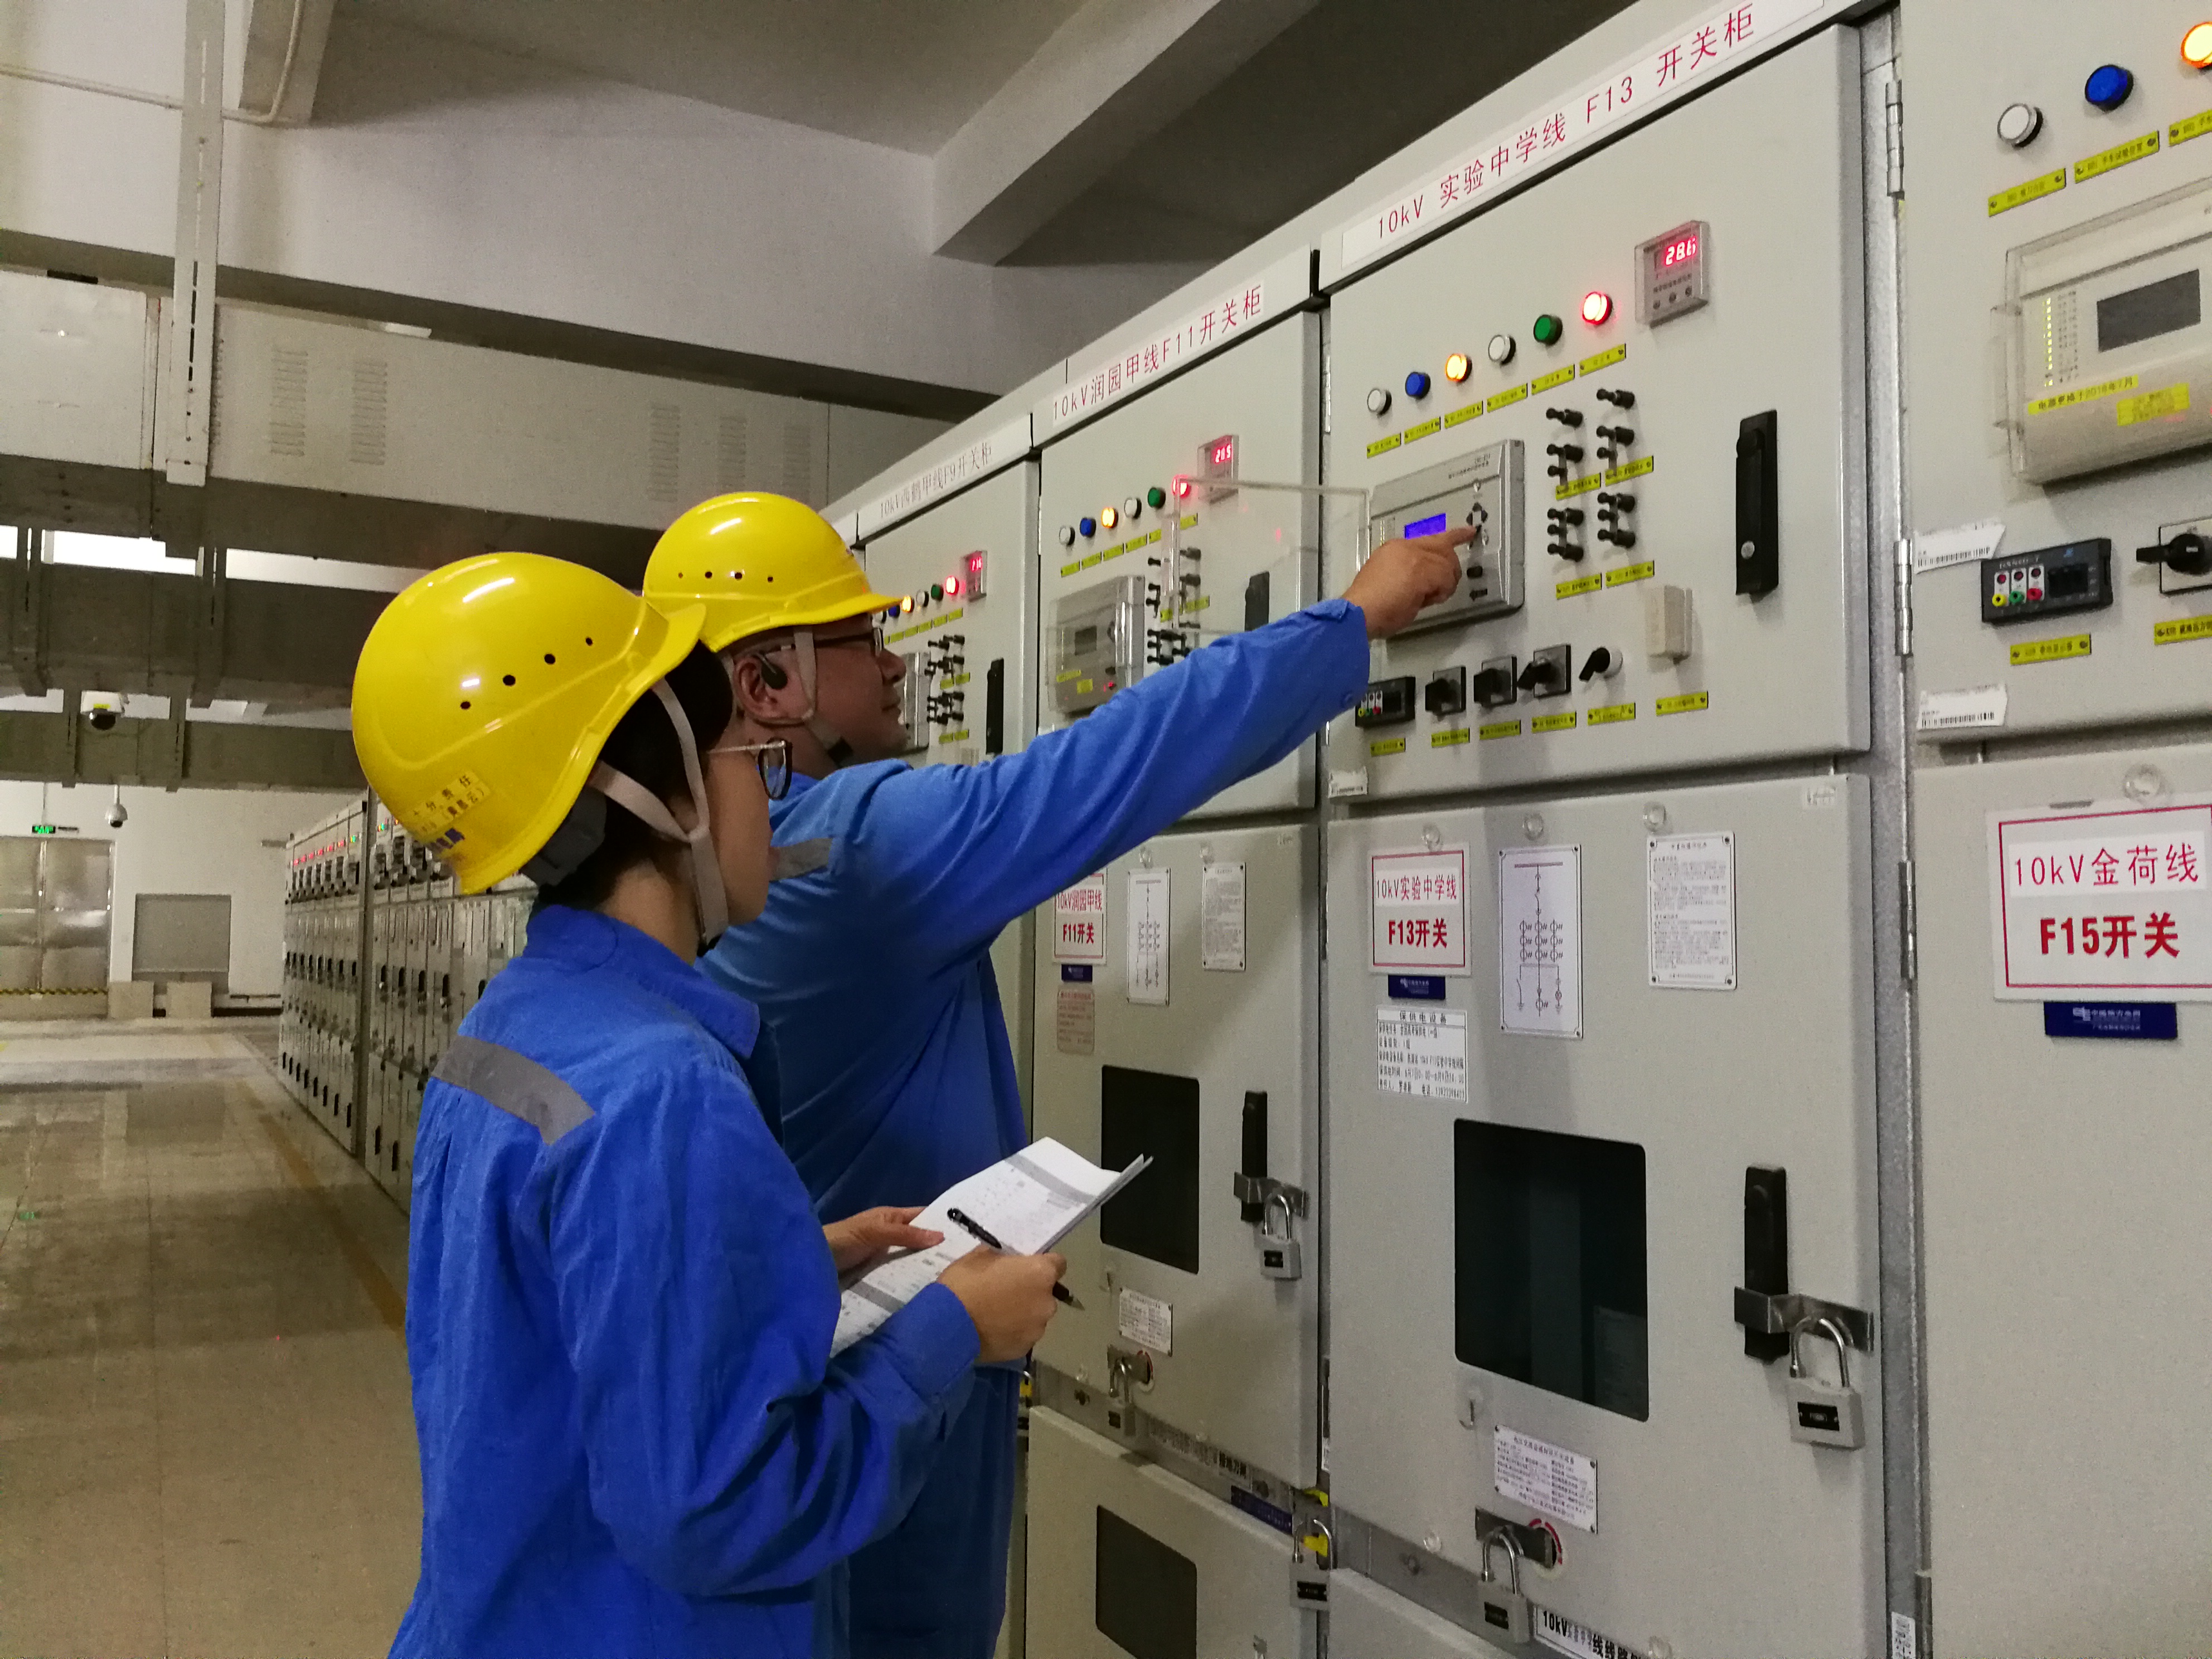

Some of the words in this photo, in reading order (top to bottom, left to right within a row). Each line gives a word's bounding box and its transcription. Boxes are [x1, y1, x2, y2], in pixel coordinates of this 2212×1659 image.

[1379, 196, 1423, 238] 10kV
[1440, 113, 1566, 208] 实验中学线
[1587, 76, 1633, 124] F13
[1656, 4, 1754, 88] 开关柜
[2015, 842, 2198, 886] 10kV金荷线
[1376, 874, 1457, 901] 10kV实验中学线
[1063, 921, 1094, 944] F11开关
[1388, 918, 1448, 949] F13开关
[2040, 911, 2180, 959] F15开关
